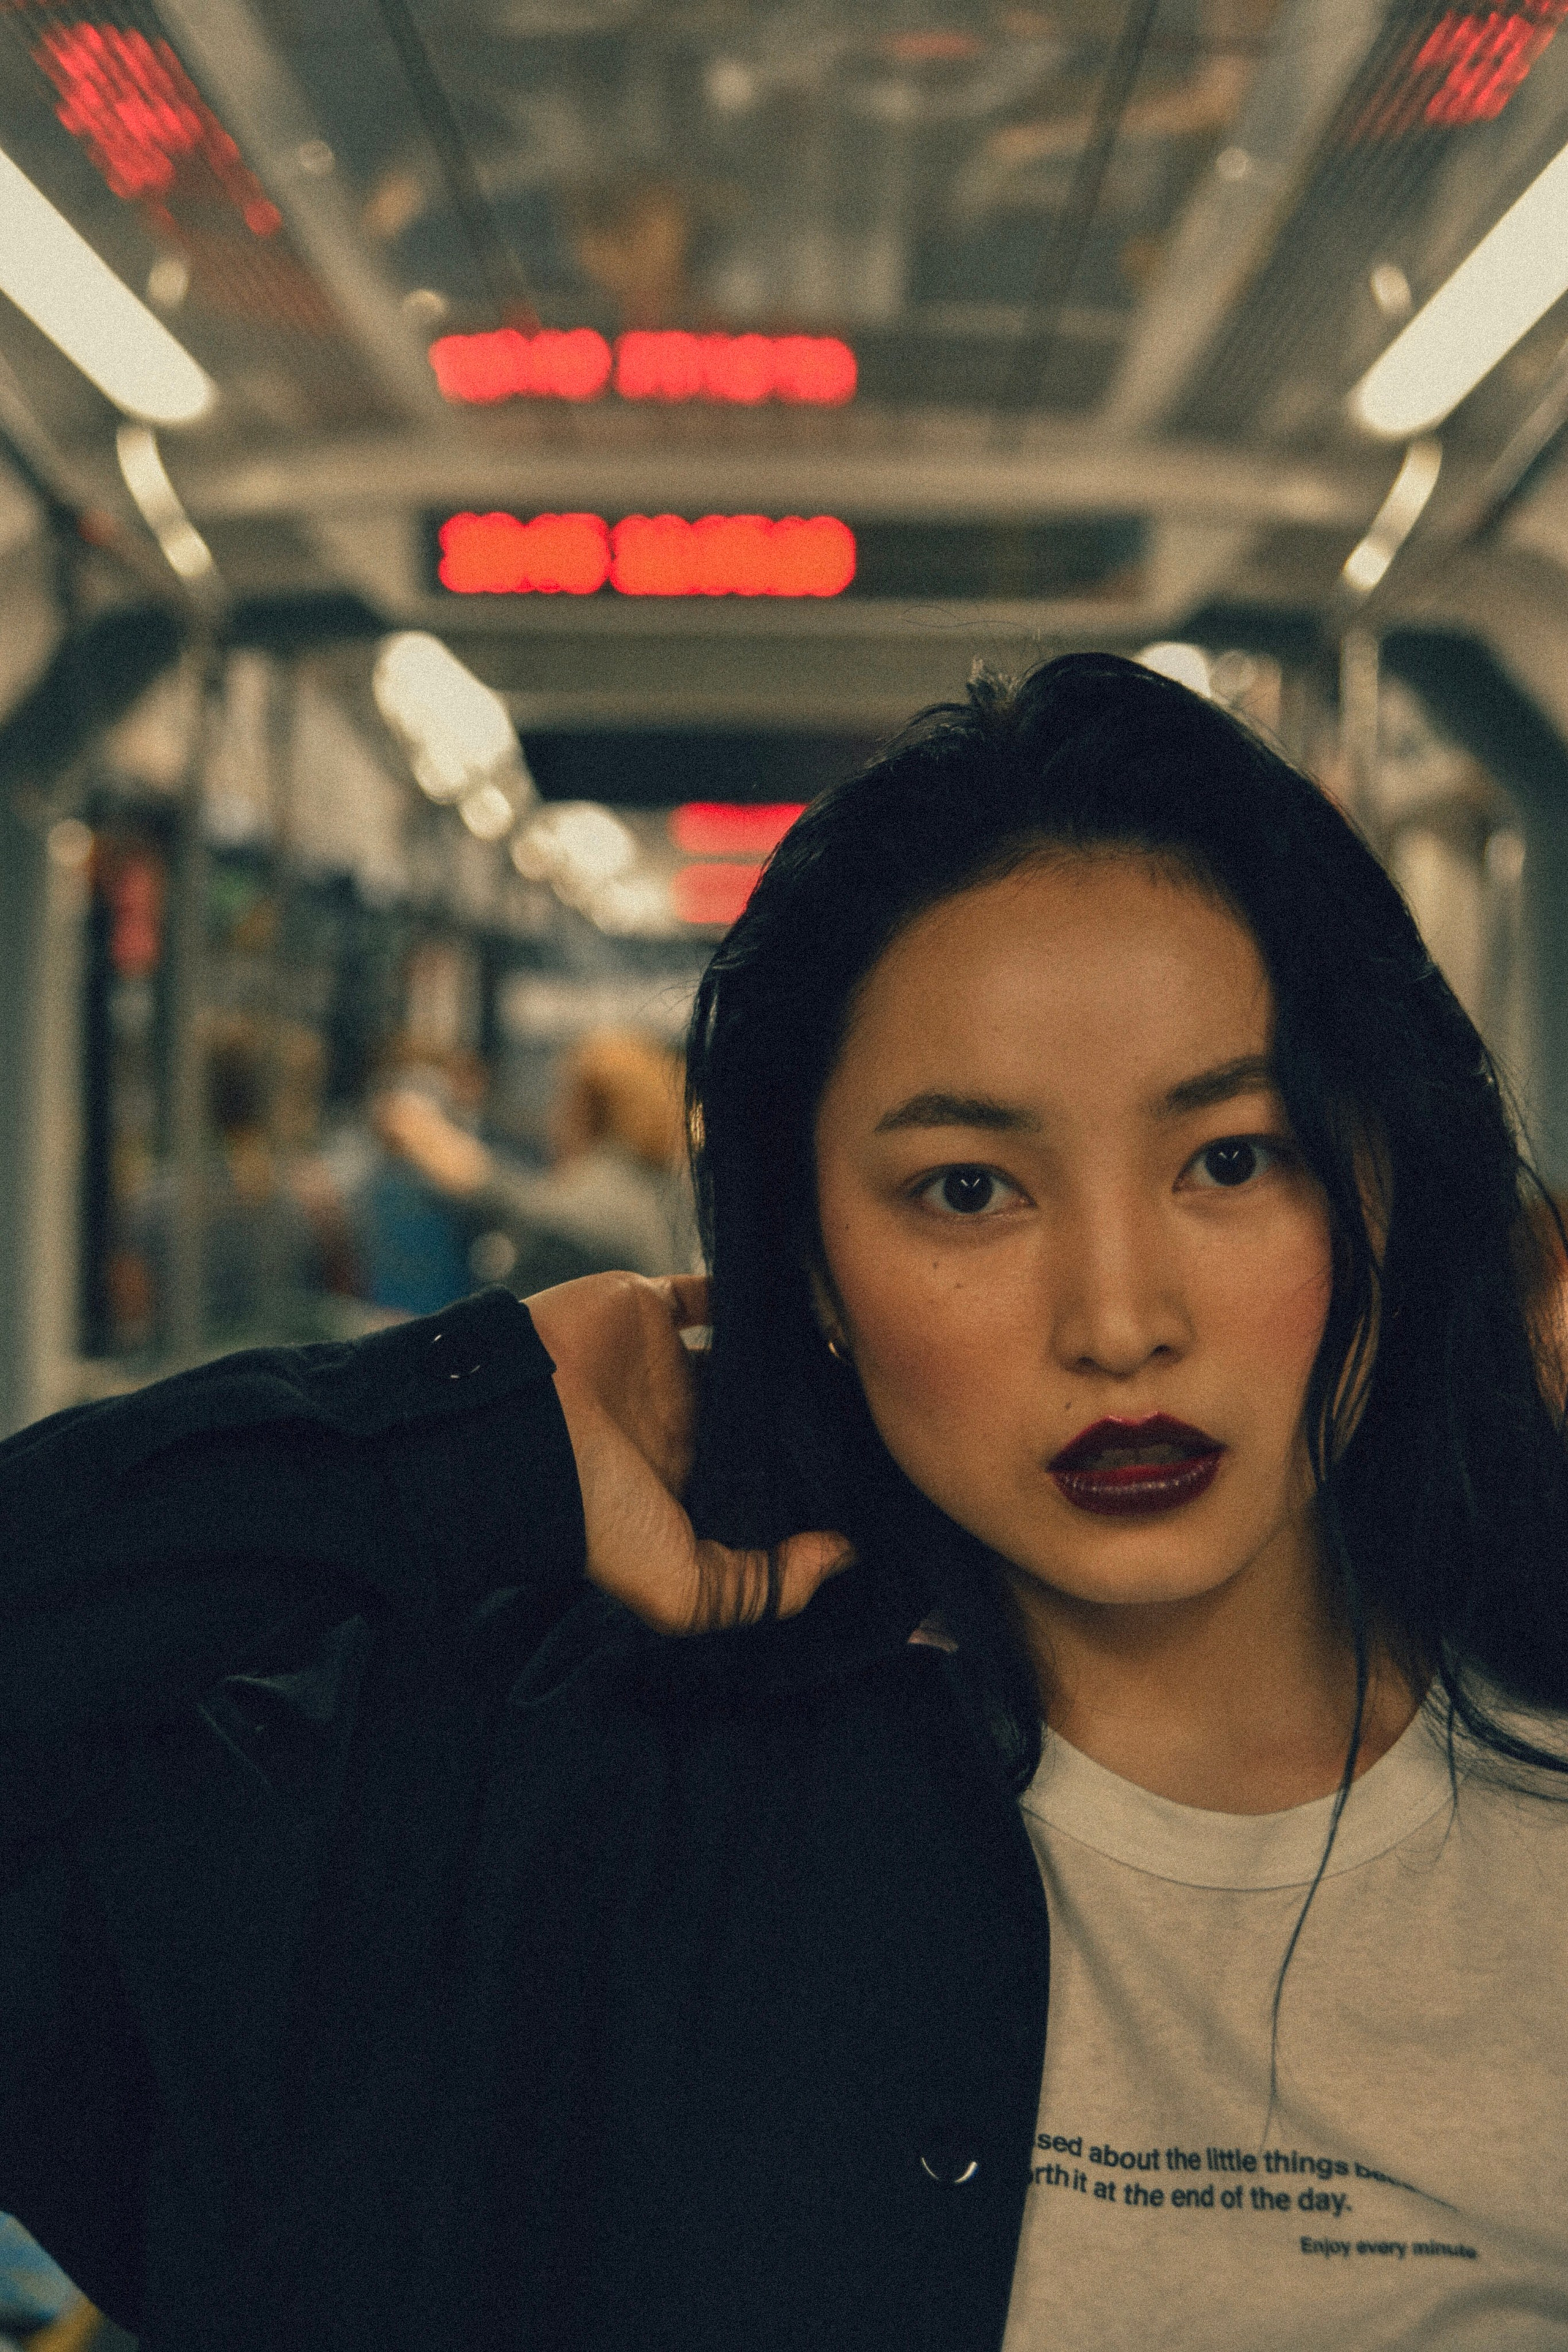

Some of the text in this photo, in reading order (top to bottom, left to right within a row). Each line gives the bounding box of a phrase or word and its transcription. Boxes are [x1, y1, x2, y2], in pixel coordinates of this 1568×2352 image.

[1088, 2144, 1161, 2171] about
[1165, 2147, 1202, 2171] the
[1206, 2147, 1258, 2174] little
[1262, 2149, 1350, 2180] things
[1030, 2163, 1069, 2187] rth
[1072, 2168, 1088, 2193] it
[1093, 2181, 1117, 2203] at
[1123, 2182, 1165, 2208] the
[1170, 2184, 1215, 2209] end
[1219, 2185, 1243, 2210] of
[1250, 2187, 1292, 2212] the
[1297, 2187, 1352, 2218] day.
[1300, 2236, 1478, 2260] Enjoy every minute
